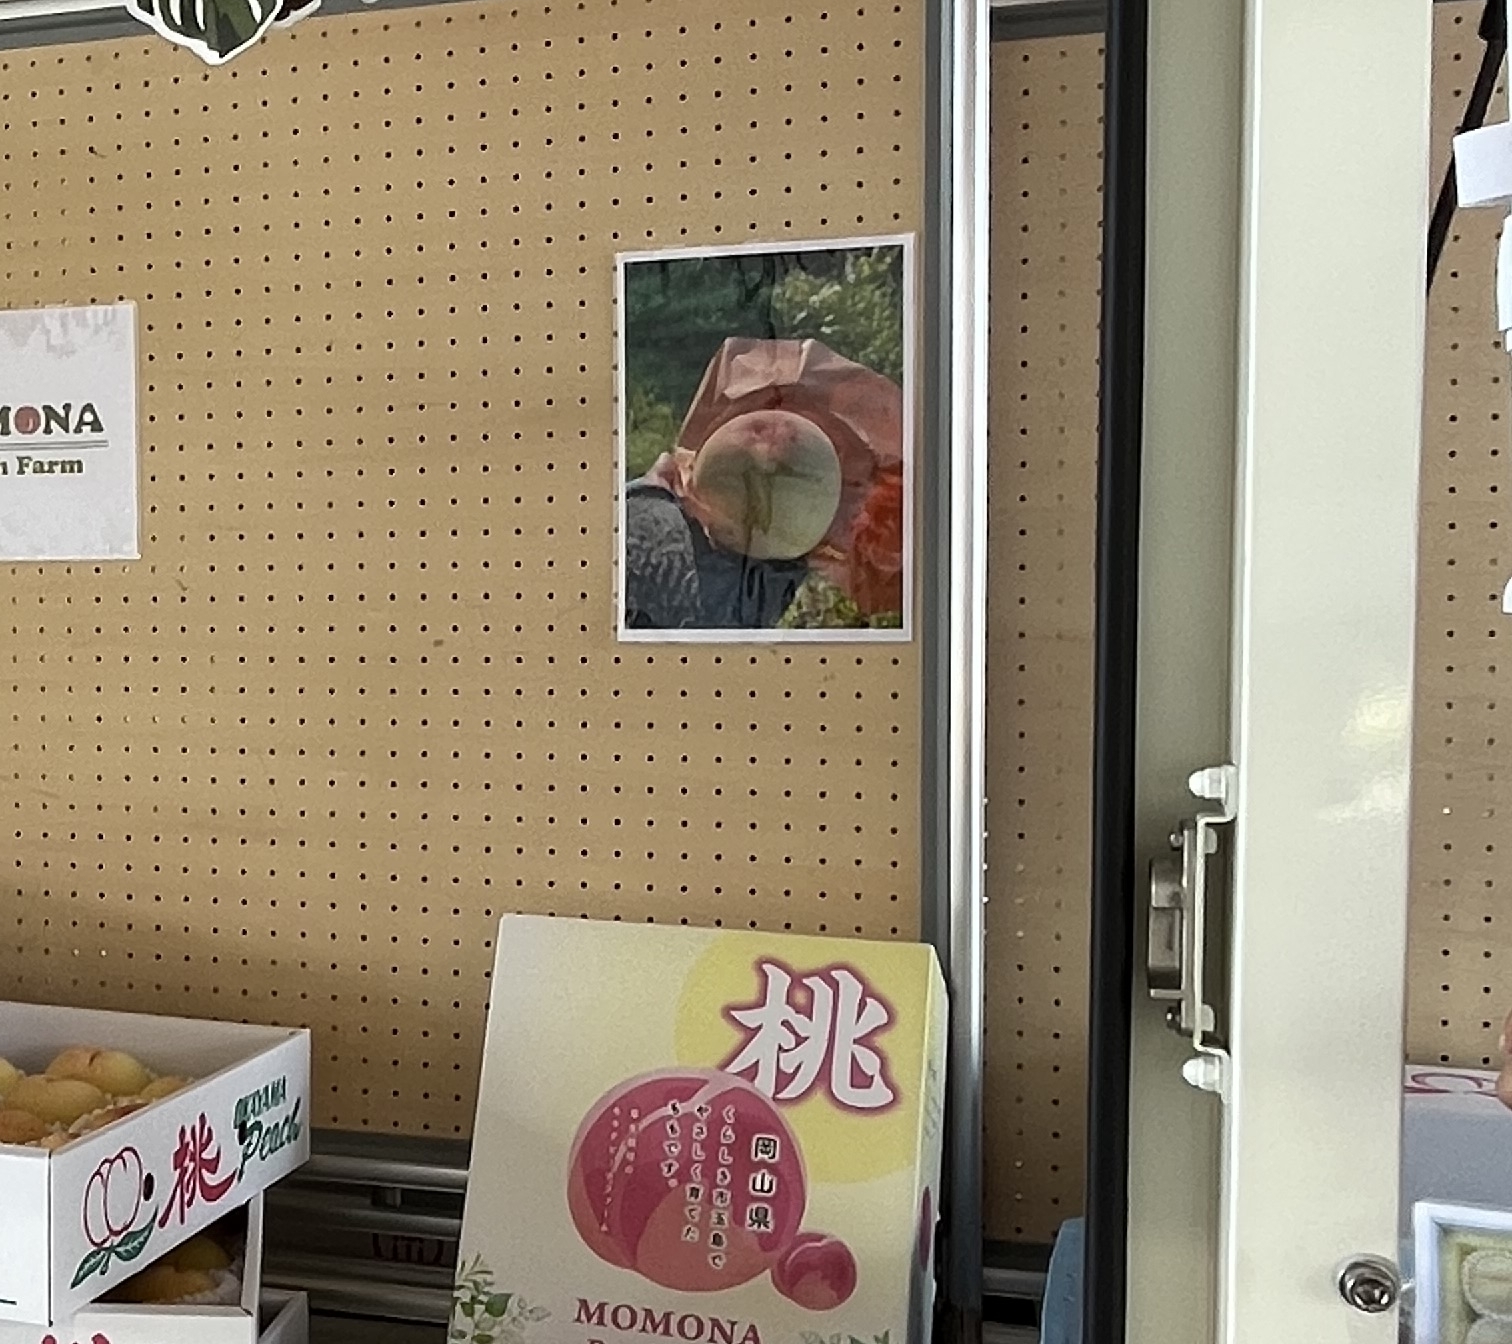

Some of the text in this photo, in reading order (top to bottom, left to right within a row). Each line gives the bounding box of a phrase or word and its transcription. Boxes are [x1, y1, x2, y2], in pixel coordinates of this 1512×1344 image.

[16, 455, 85, 476] Farm
[722, 960, 898, 1111] 桃
[157, 1112, 238, 1229] 桃
[238, 1097, 301, 1183] Peach
[745, 1133, 781, 1234] 岡山県
